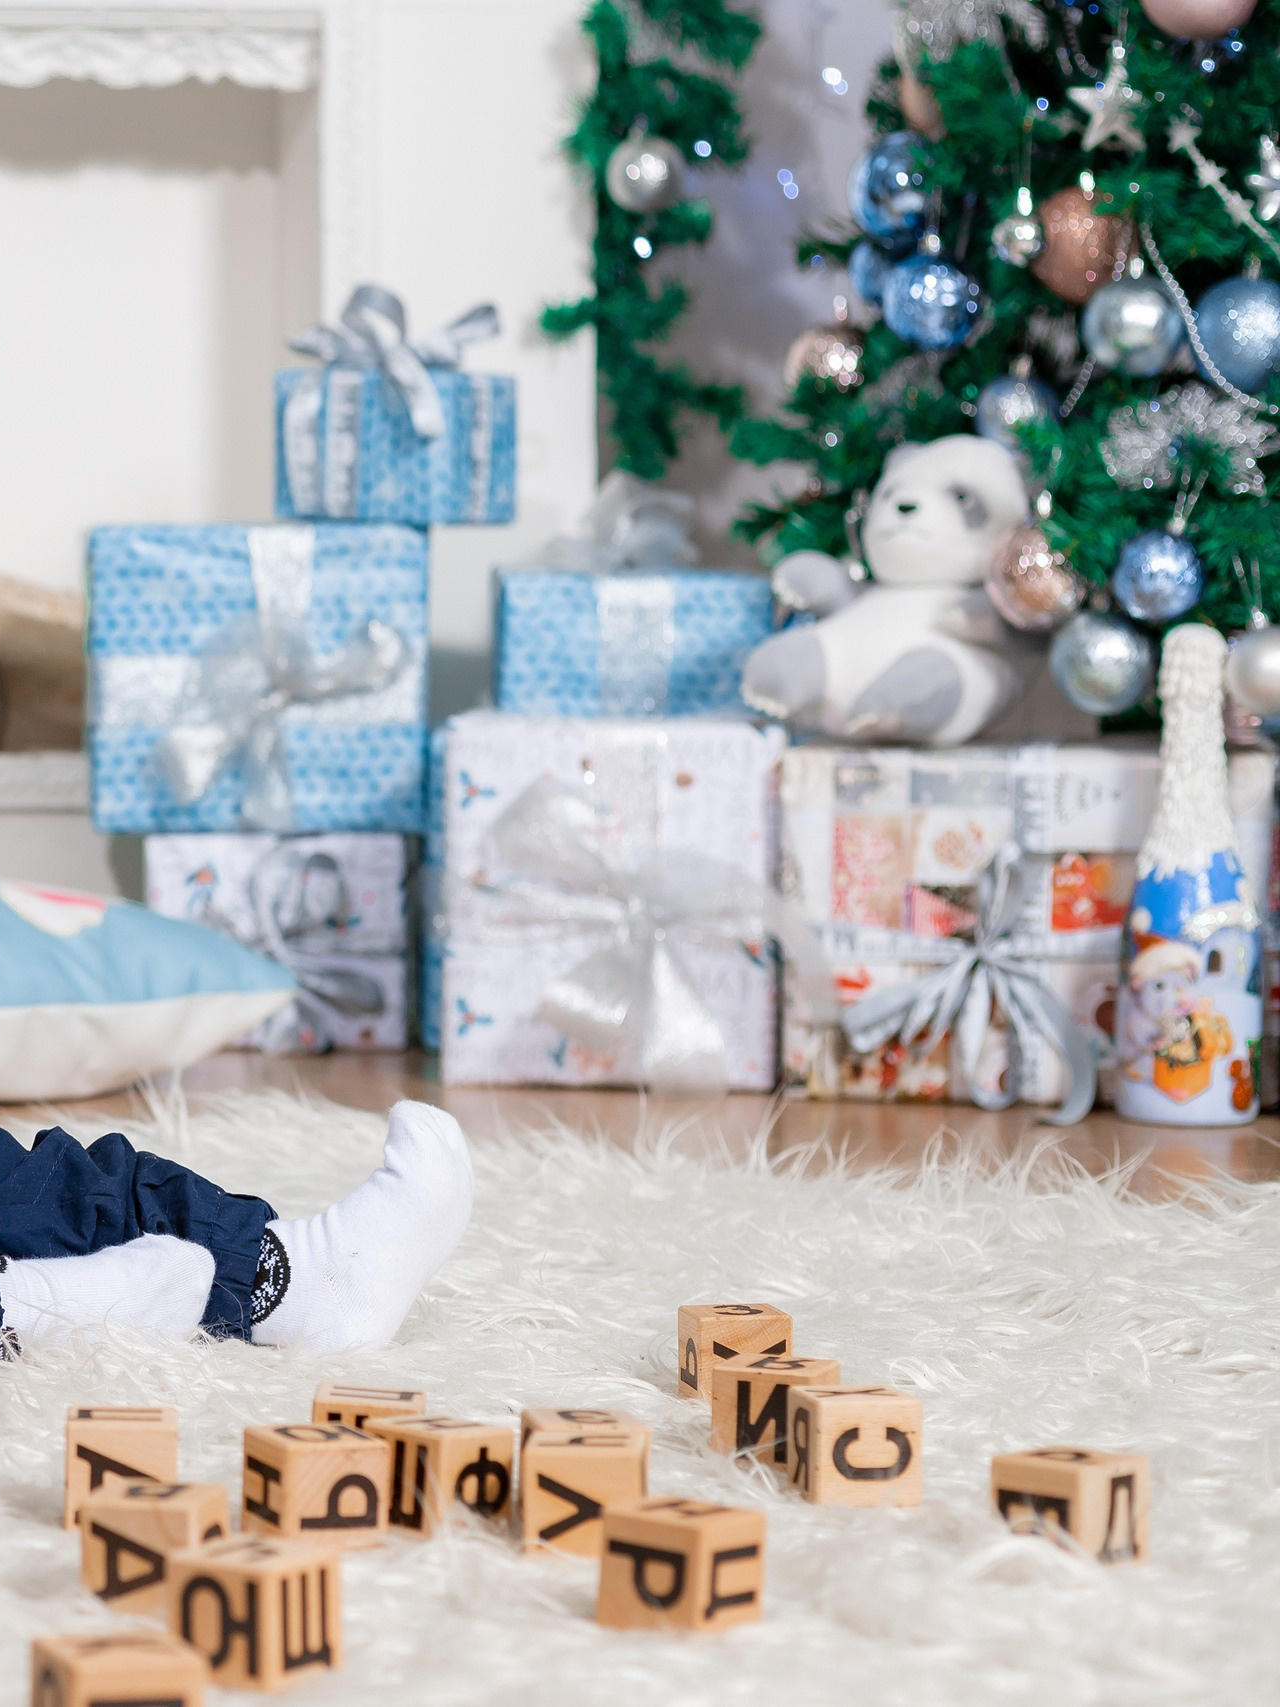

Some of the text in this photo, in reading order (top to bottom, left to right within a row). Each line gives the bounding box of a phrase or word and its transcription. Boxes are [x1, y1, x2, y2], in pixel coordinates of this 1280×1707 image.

[737, 1380, 790, 1464] И
[455, 1447, 509, 1518] Ф
[91, 1522, 164, 1599] А
